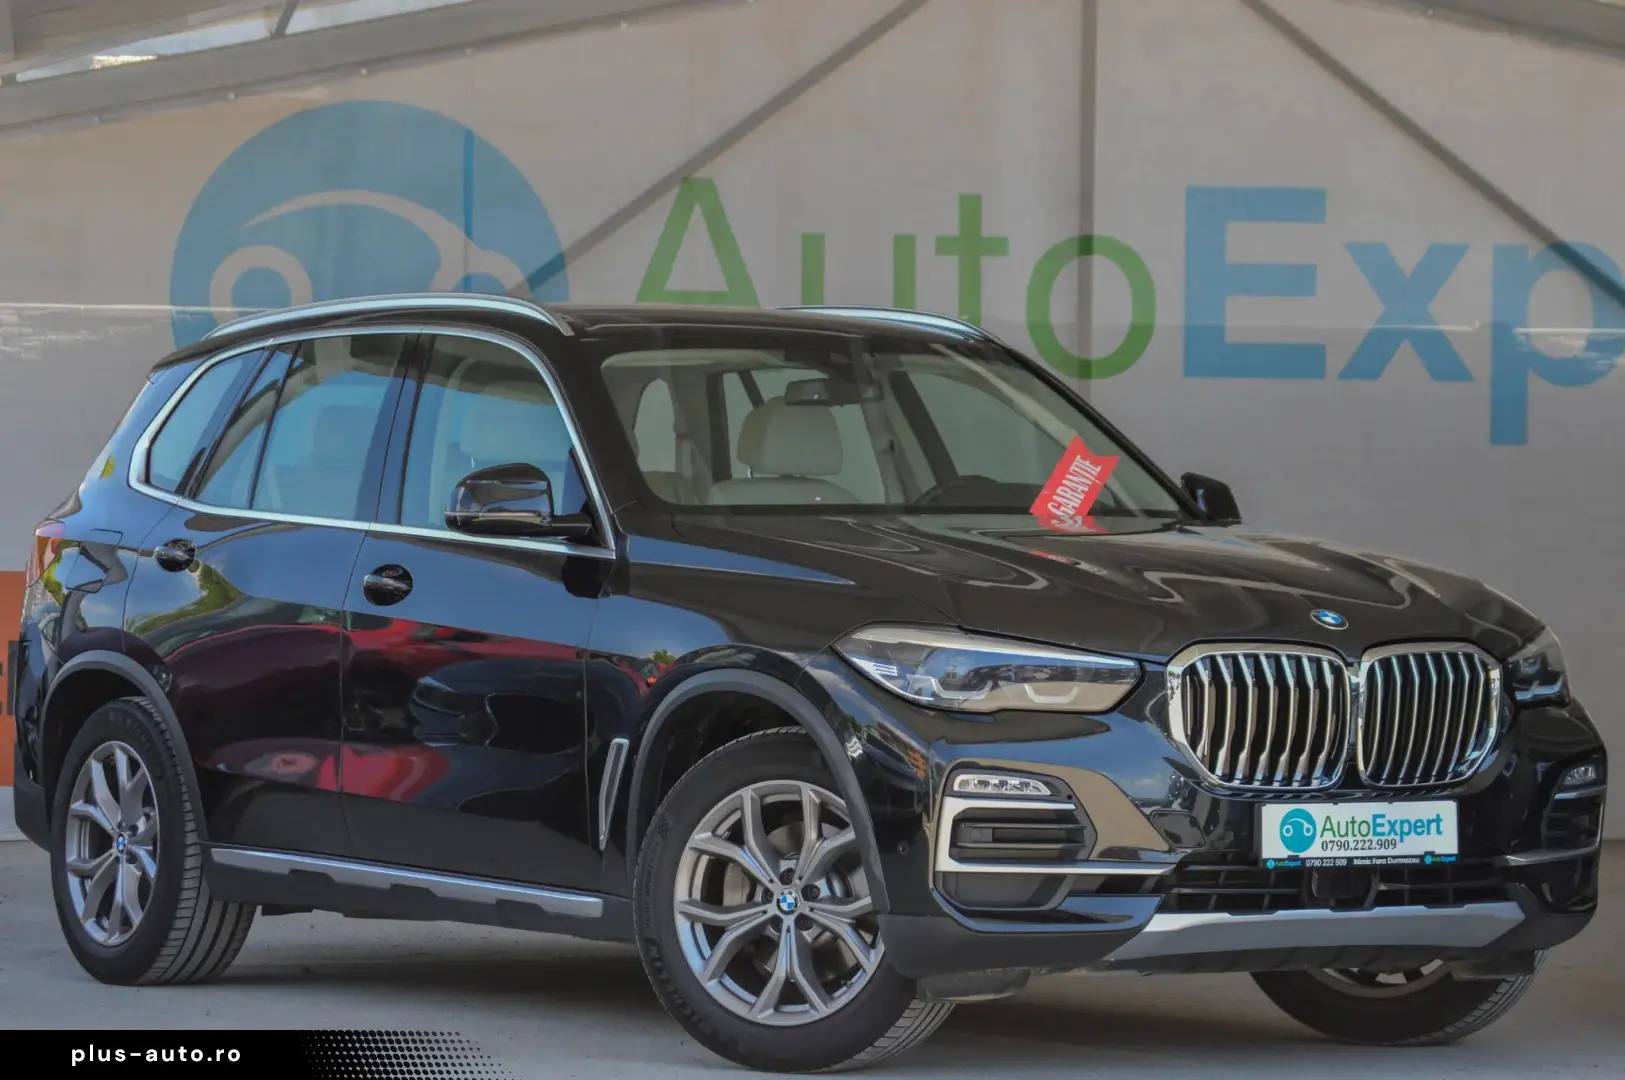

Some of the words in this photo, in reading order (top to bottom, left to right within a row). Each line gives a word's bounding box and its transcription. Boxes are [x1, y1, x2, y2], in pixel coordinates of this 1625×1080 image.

[1319, 813, 1443, 843] AutoExpert
[1321, 838, 1397, 852] 0790.222.909
[1305, 859, 1321, 867] 0790
[1322, 858, 1334, 866] 222
[1335, 858, 1347, 866] 909
[1353, 857, 1372, 865] Nimic
